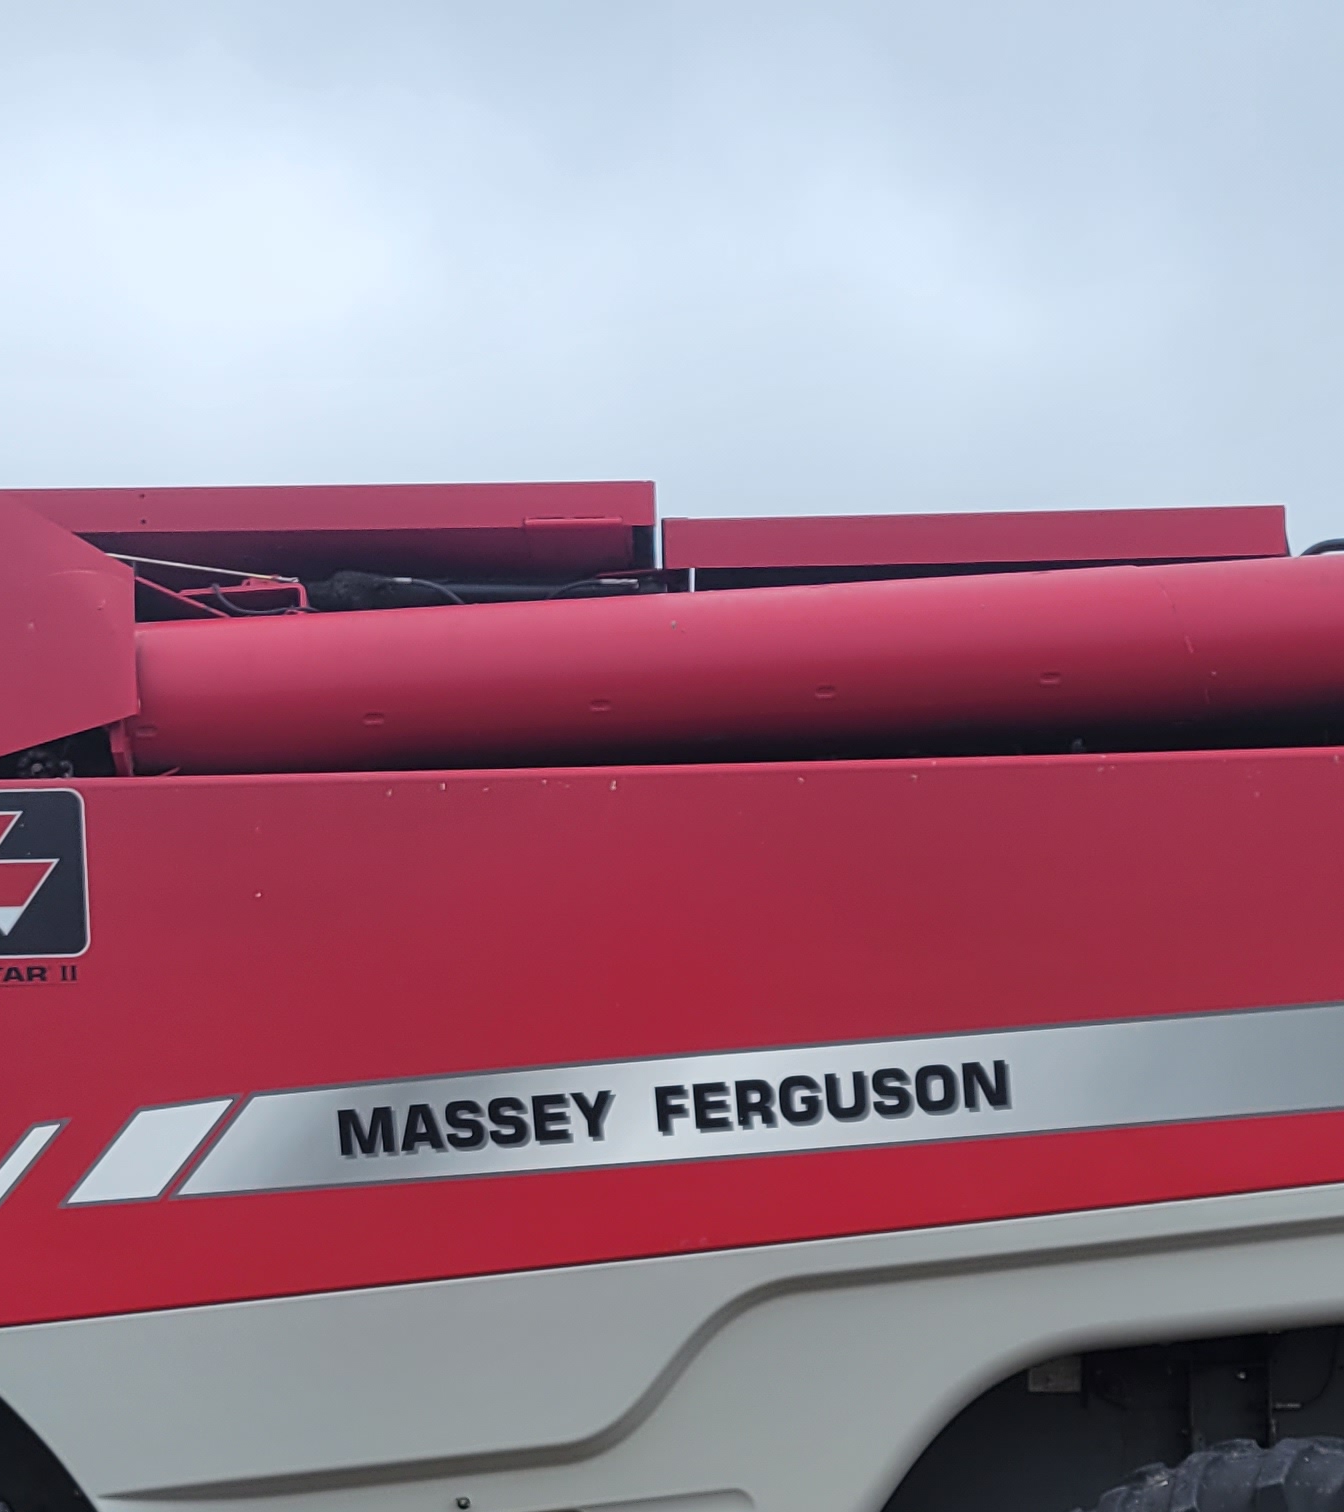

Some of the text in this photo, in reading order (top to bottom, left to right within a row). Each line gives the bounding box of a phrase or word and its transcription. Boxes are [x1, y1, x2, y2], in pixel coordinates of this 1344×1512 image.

[60, 965, 78, 981] II
[337, 1060, 1012, 1159] MASSEY FERGUSON
